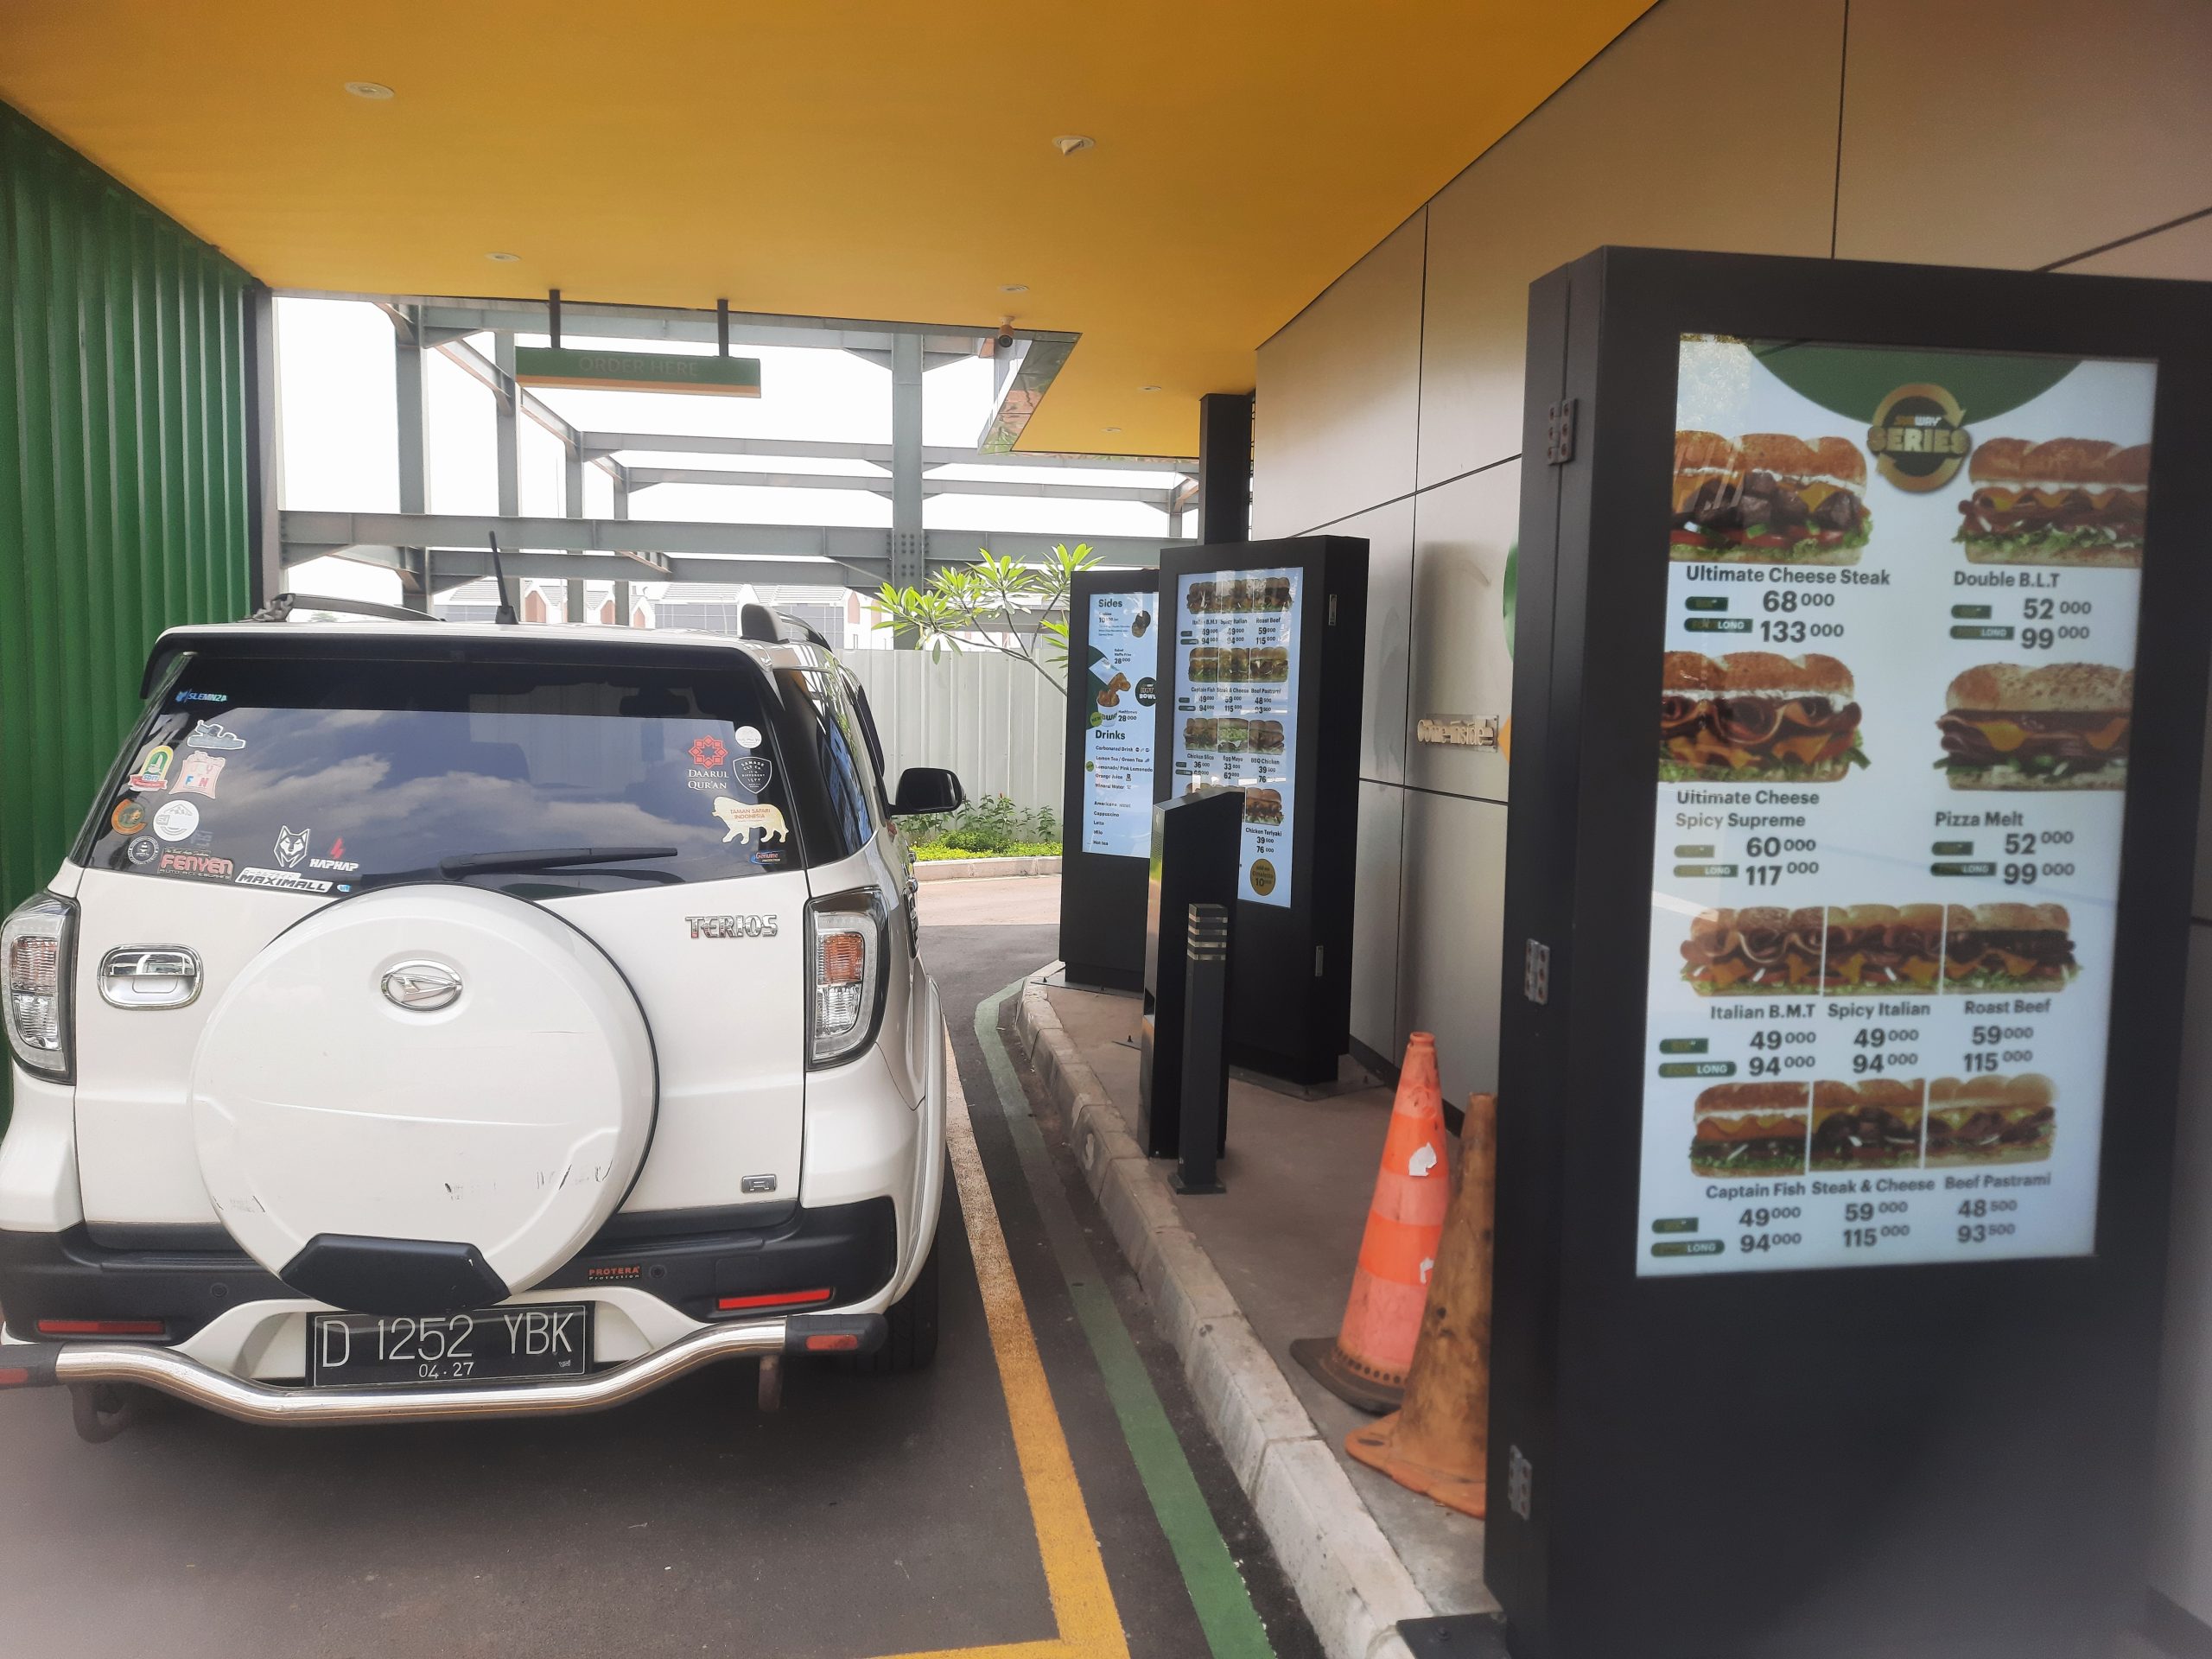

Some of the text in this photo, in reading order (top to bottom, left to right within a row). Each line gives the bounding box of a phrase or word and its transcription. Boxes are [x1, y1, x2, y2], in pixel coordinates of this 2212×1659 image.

[579, 356, 699, 377] ORDER HERE
[1866, 426, 1972, 455] SERIES
[1686, 565, 1891, 587] Ultimate Cheese Steak
[1954, 570, 2060, 588] Double B.L.T
[1098, 599, 1122, 607] Sides
[1763, 590, 1798, 613] 68
[2022, 598, 2092, 620] 52 000
[1760, 620, 1844, 644] 133 000
[2021, 626, 2090, 650] 99 000
[1095, 729, 1125, 740] Drinks
[688, 769, 729, 779] DAARUL
[1677, 790, 1820, 806] Ultimate Cheese
[1675, 812, 1806, 830] Spicy Supreme
[1935, 811, 2024, 828] Pizza Melt
[2004, 830, 2075, 855] 52 000
[161, 854, 233, 875] FENYEN
[309, 858, 359, 872] HAPHAP
[1745, 861, 1819, 887] 117 000
[2003, 862, 2075, 885] 99 000
[238, 874, 326, 892] MAXIMALL
[685, 914, 779, 938] TERIOS
[1710, 1002, 1815, 1020] Italian B.M.T
[1827, 1001, 1930, 1020] Spicy Italian
[1965, 997, 2052, 1016] Roast Beef
[1750, 1029, 1783, 1052] 49
[1854, 1027, 1886, 1048] 49
[1749, 1054, 1782, 1077] 94
[1853, 1052, 1885, 1074] 94
[1963, 1049, 2033, 1072] 115 000
[1706, 1181, 1806, 1202] Captain Fish
[1812, 1177, 1936, 1196] Steak & Cheese
[1944, 1173, 2052, 1191] Beef Pastrami
[1844, 1203, 1875, 1223] 59
[1843, 1228, 1877, 1249] 115
[588, 1267, 639, 1276] PROTERA
[322, 1311, 573, 1369] D 1252 YBK
